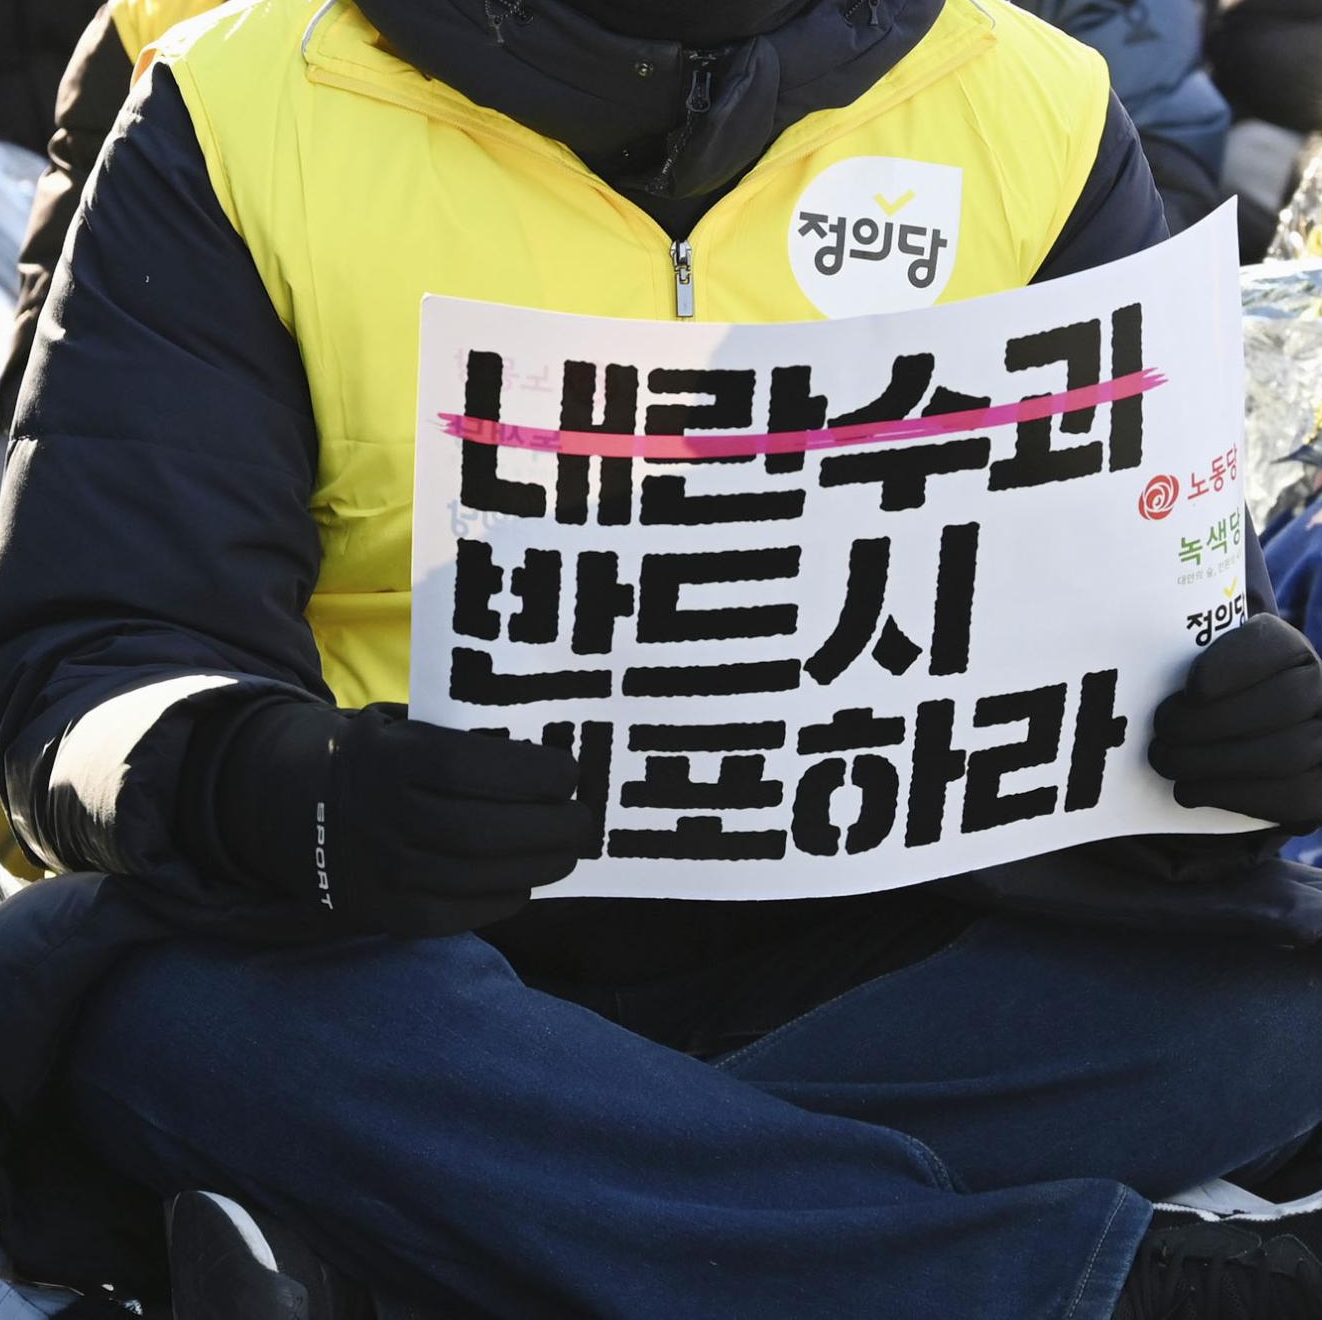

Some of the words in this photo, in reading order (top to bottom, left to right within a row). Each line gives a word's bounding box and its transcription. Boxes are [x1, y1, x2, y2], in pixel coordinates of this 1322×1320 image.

[798, 211, 947, 288] 정의당
[459, 302, 1143, 527] 내란수괴
[1187, 442, 1237, 500] 노동당
[1178, 506, 1241, 566] 녹색당
[449, 521, 981, 707] 반드시
[315, 801, 334, 910] SPORT
